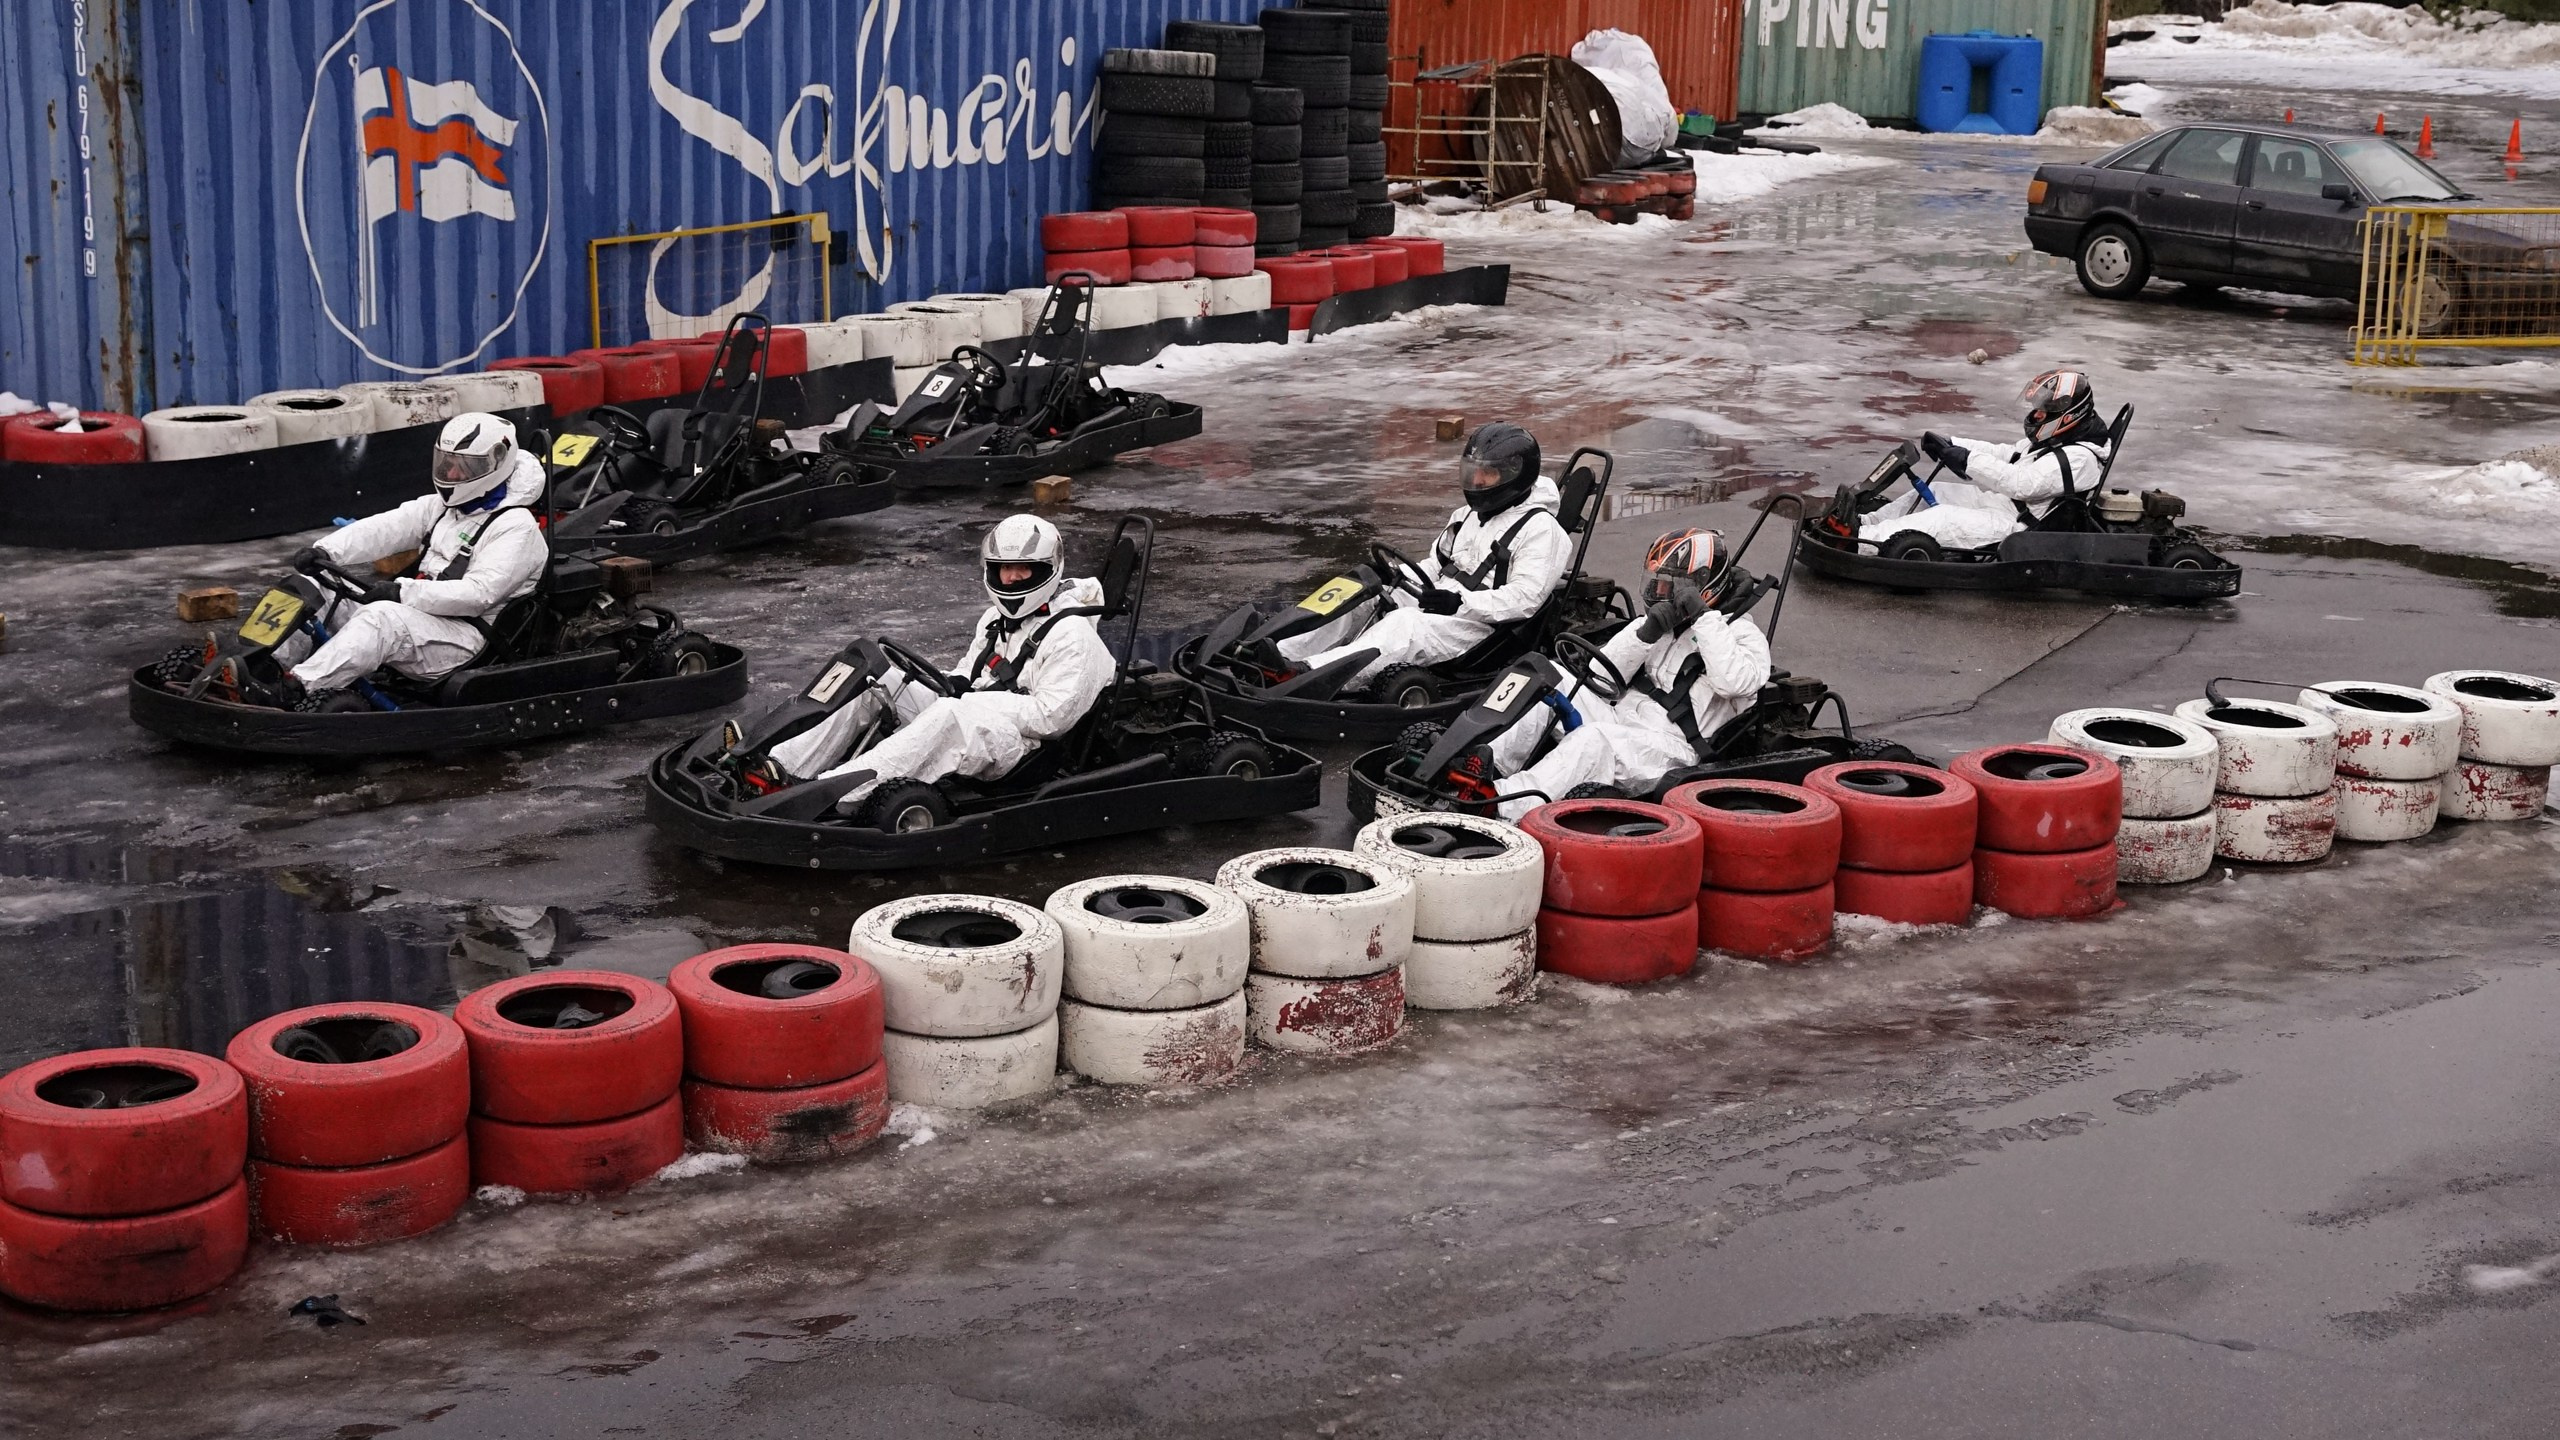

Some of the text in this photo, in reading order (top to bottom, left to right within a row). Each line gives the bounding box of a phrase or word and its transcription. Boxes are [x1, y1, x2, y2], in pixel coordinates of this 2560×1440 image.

[74, 0, 95, 276] SKU 679 119 9
[931, 380, 944, 392] 8
[558, 443, 578, 458] 4
[1317, 587, 1342, 603] 6
[254, 602, 287, 631] 14
[822, 672, 842, 693] 1
[1496, 681, 1516, 702] 3
